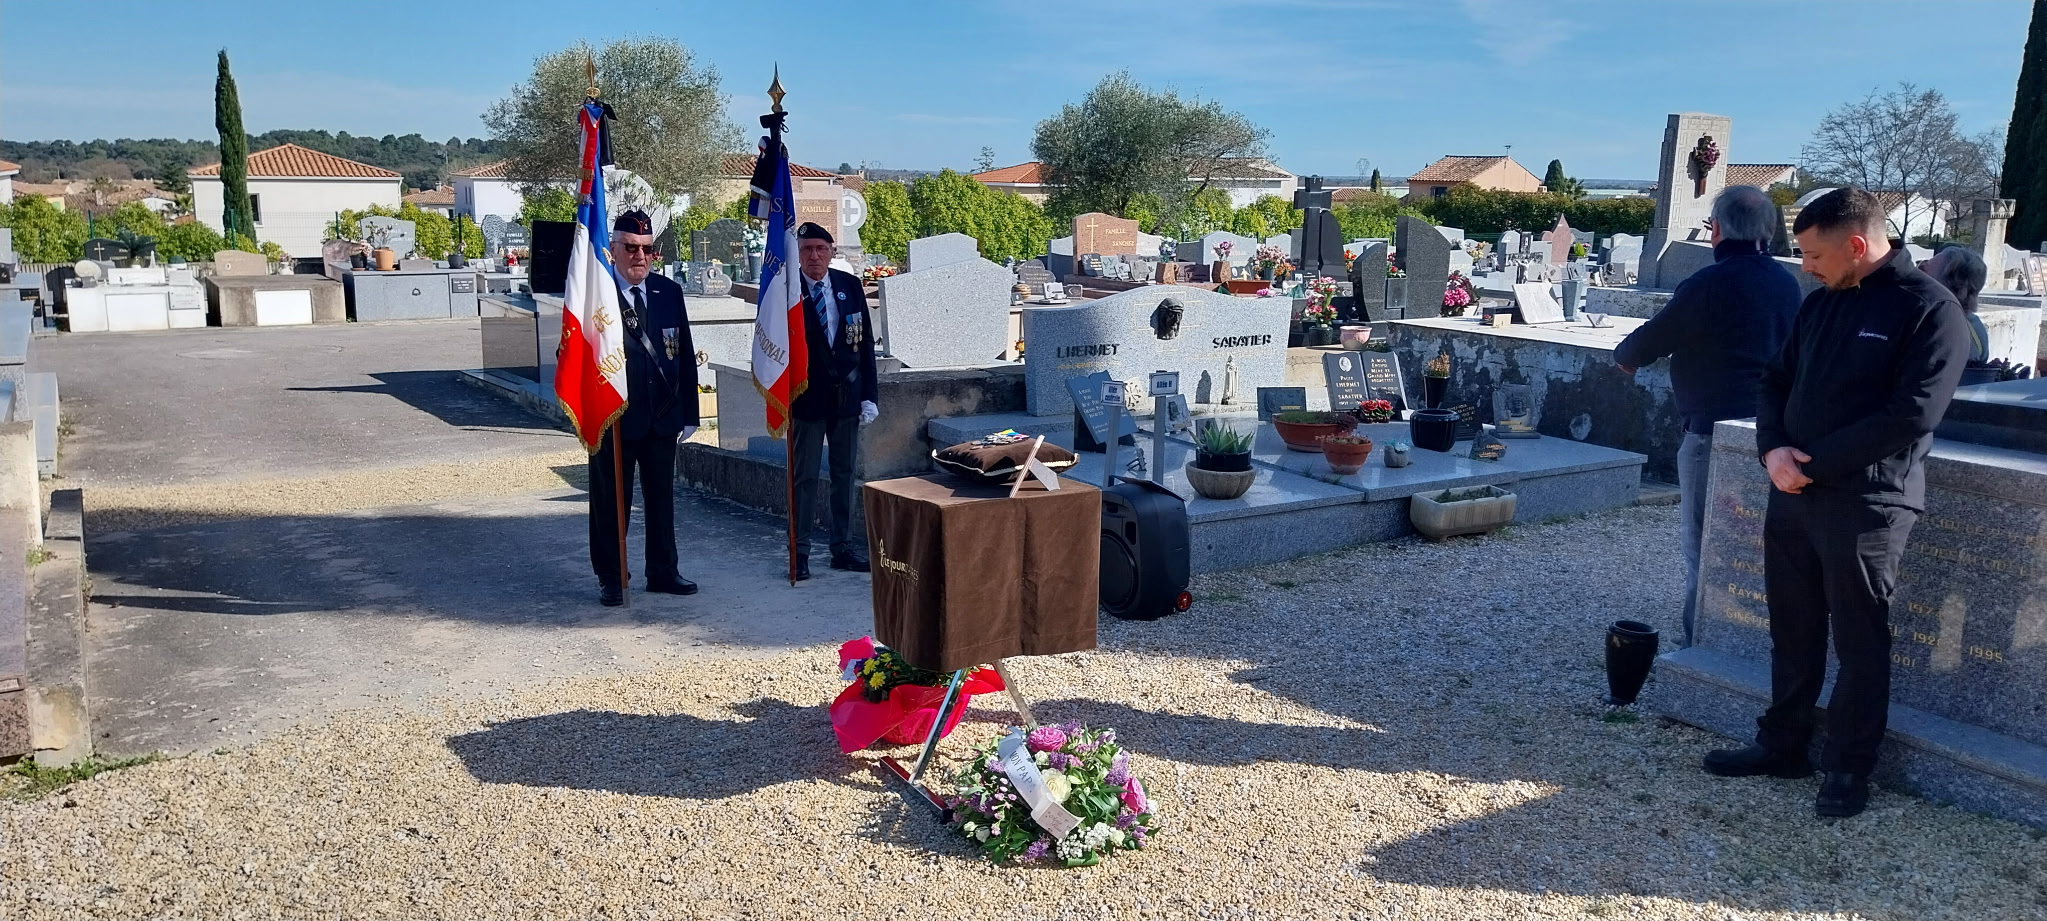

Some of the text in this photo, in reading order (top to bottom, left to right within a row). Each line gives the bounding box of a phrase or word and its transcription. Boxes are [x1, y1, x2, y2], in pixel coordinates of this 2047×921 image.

[801, 205, 832, 213] FAMILLE
[1212, 334, 1271, 349] SABATIER
[1969, 646, 2004, 663] 1995
